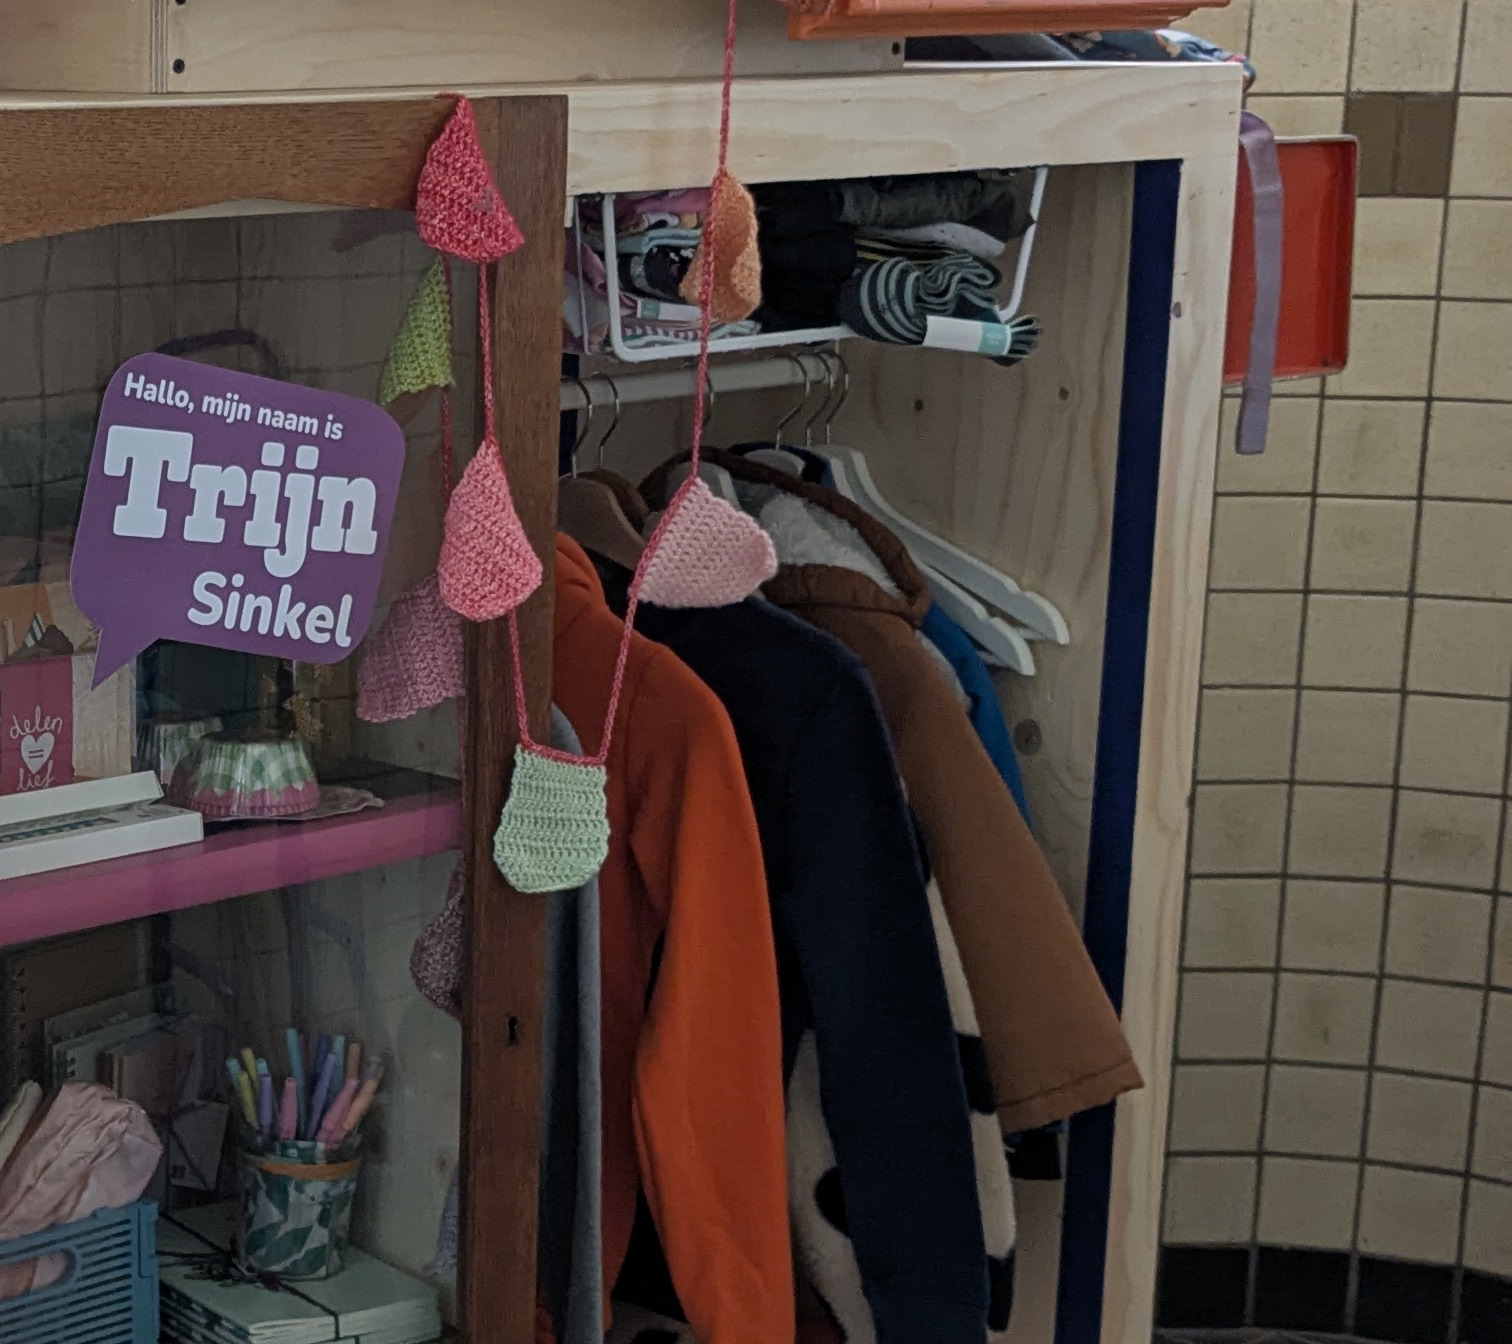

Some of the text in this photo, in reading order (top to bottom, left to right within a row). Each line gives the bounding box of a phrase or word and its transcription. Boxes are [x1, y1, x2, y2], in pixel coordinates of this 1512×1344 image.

[124, 372, 344, 440] Hallo, mijn naam is
[103, 425, 378, 578] Trijn
[187, 571, 354, 648] Sinkel
[9, 705, 63, 739] delen
[16, 759, 54, 791] lief
